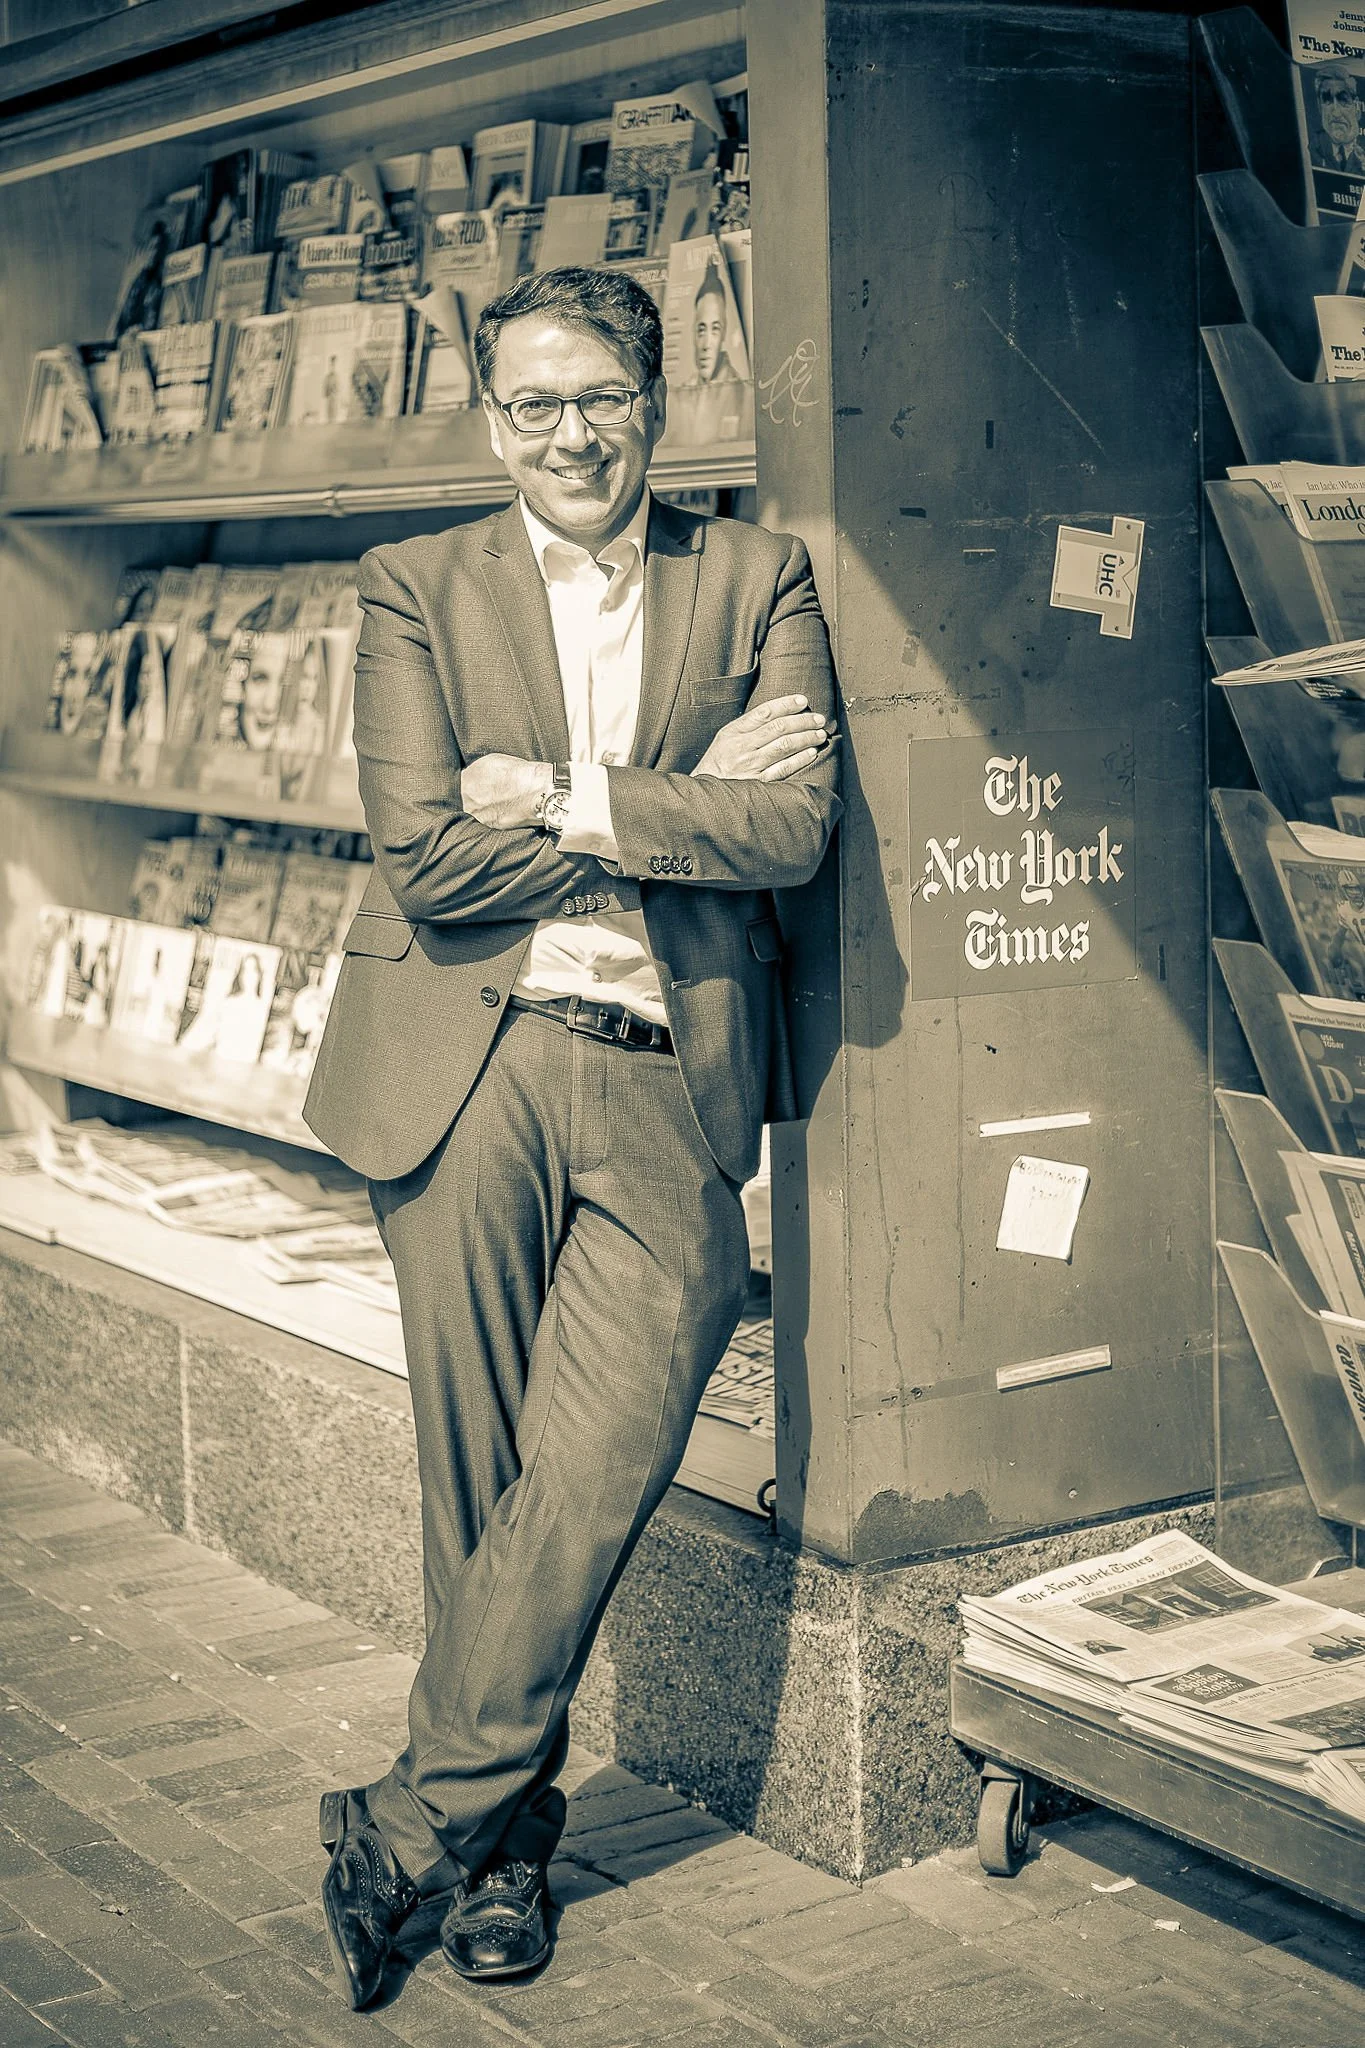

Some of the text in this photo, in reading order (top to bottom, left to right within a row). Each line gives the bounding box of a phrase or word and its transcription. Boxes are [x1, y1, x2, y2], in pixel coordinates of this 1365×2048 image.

[1333, 20, 1365, 33] Johns
[1299, 34, 1330, 53] The
[1331, 345, 1361, 361] The
[1339, 480, 1359, 490] Who
[1099, 553, 1117, 597] UHC
[983, 754, 1064, 822] The
[922, 825, 1124, 905] New York
[964, 907, 1090, 970] Times
[1017, 1556, 1154, 1604] The New York Times
[1172, 1671, 1228, 1693] Boston
[1193, 1678, 1238, 1697] Globe
